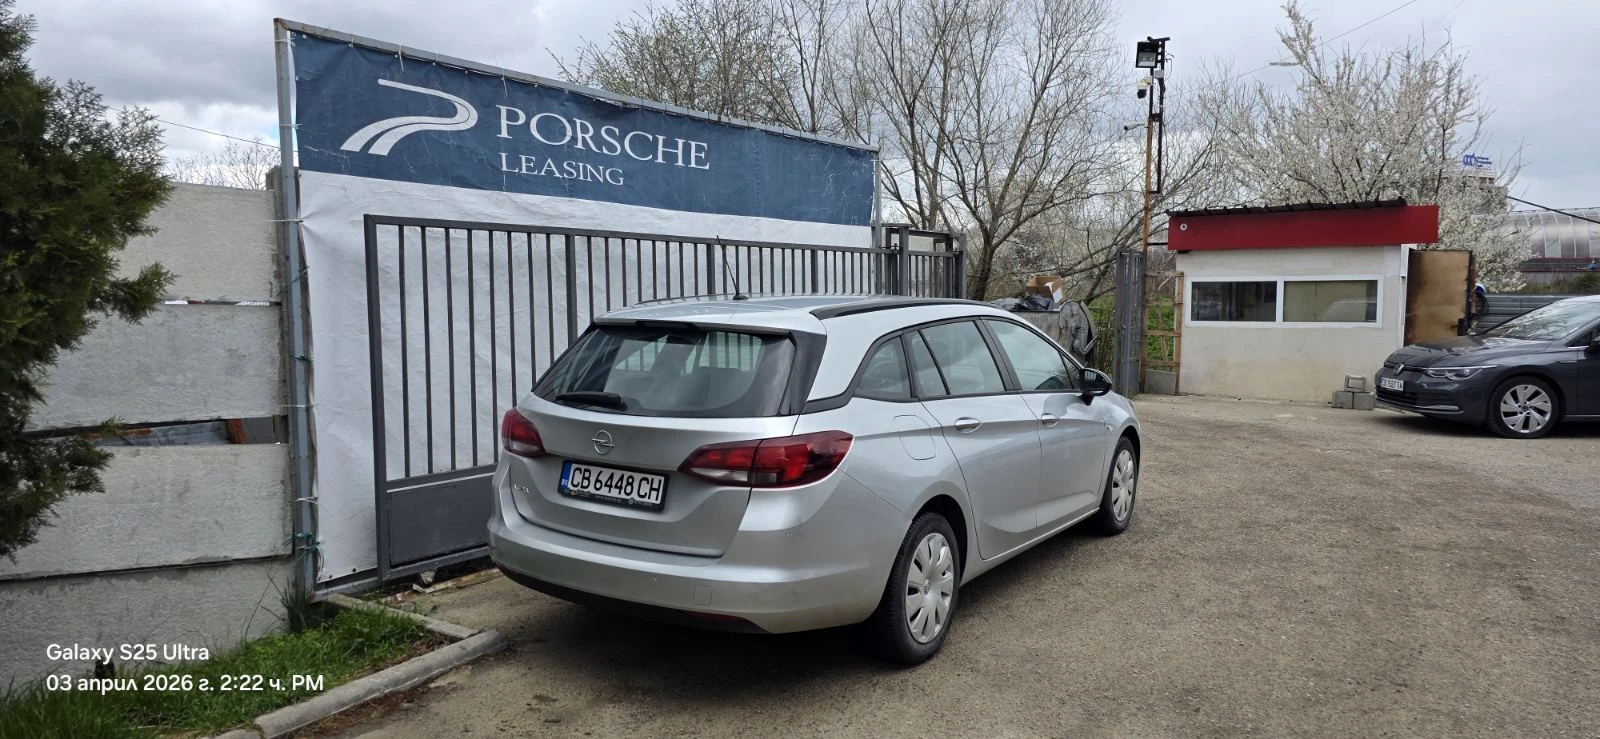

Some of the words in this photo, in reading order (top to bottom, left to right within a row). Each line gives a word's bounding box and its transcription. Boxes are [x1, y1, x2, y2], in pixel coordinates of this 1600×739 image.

[496, 104, 710, 170] PORSCHE
[499, 152, 625, 186] LEASING
[570, 467, 592, 489] CB
[593, 470, 635, 497] 6448
[637, 477, 662, 501] CH
